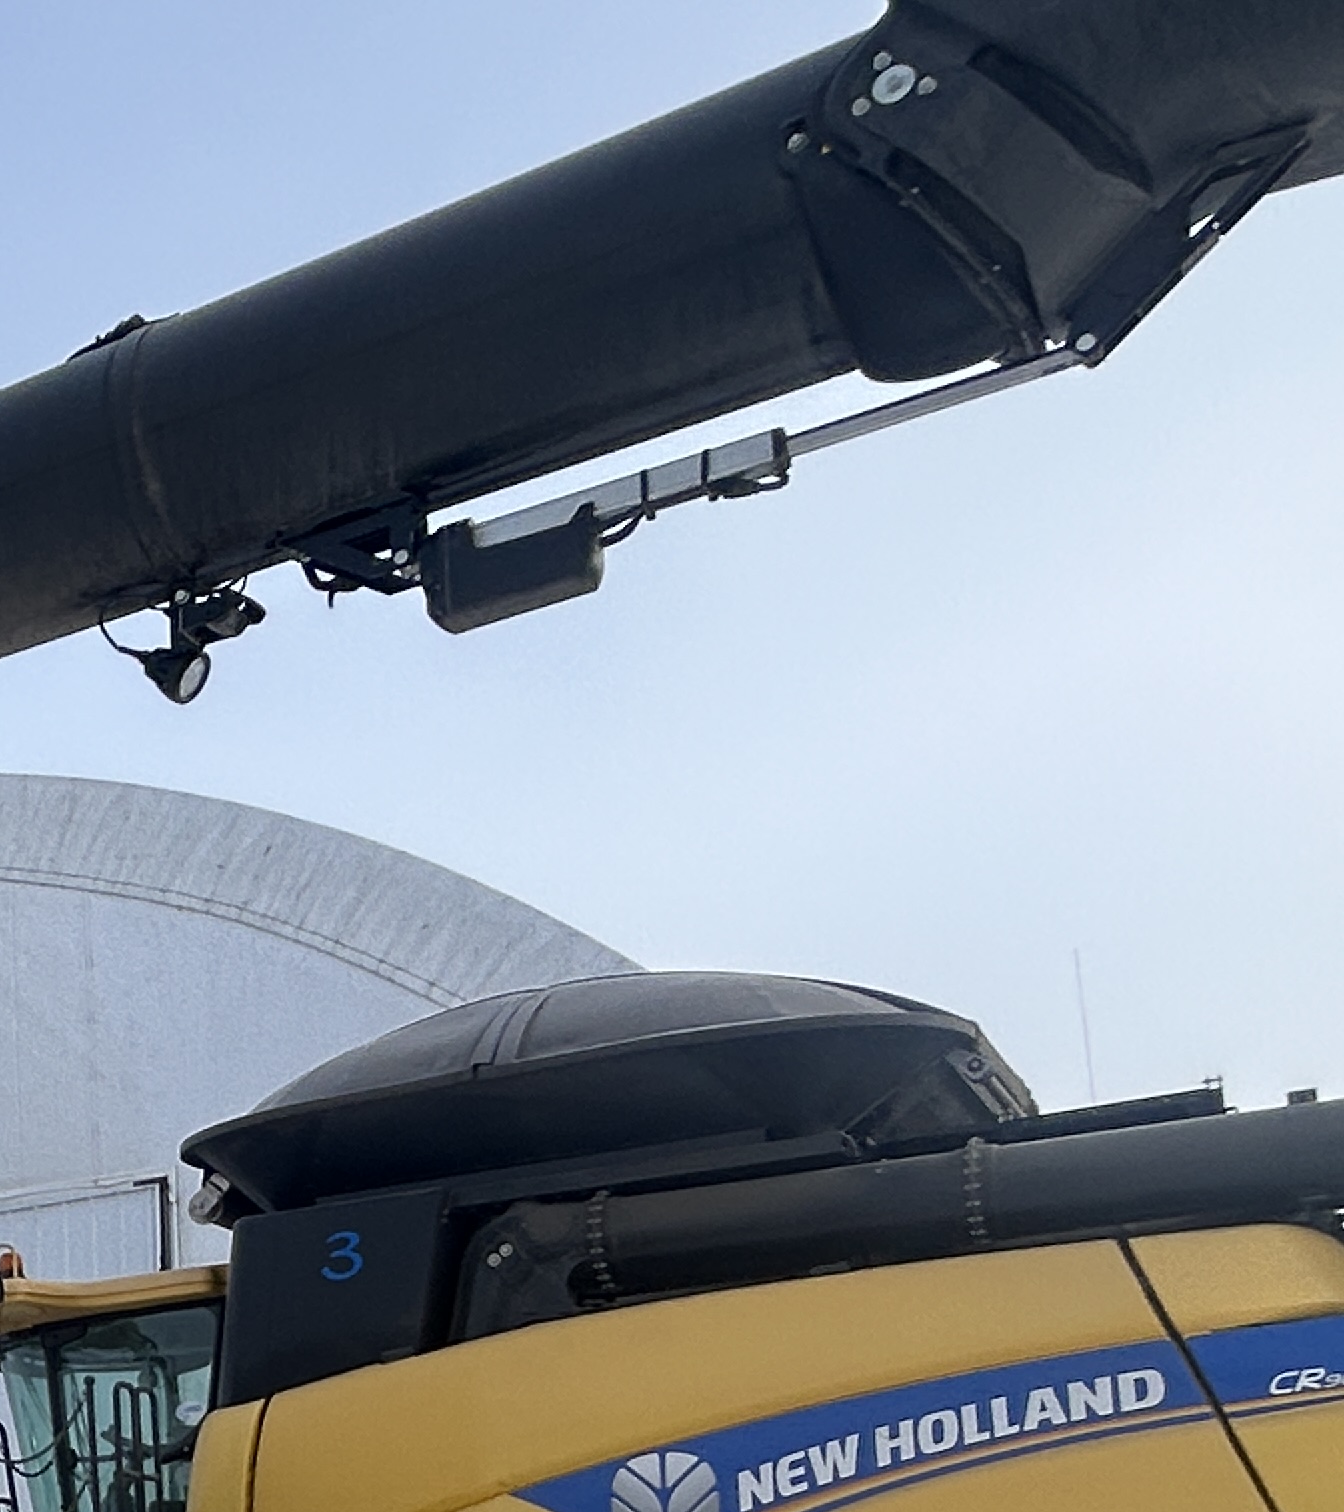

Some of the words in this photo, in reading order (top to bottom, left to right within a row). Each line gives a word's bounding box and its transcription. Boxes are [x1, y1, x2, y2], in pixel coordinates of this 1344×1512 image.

[320, 1230, 363, 1280] 3
[1269, 1368, 1344, 1395] CR9
[874, 1367, 1167, 1468] HOLLAND
